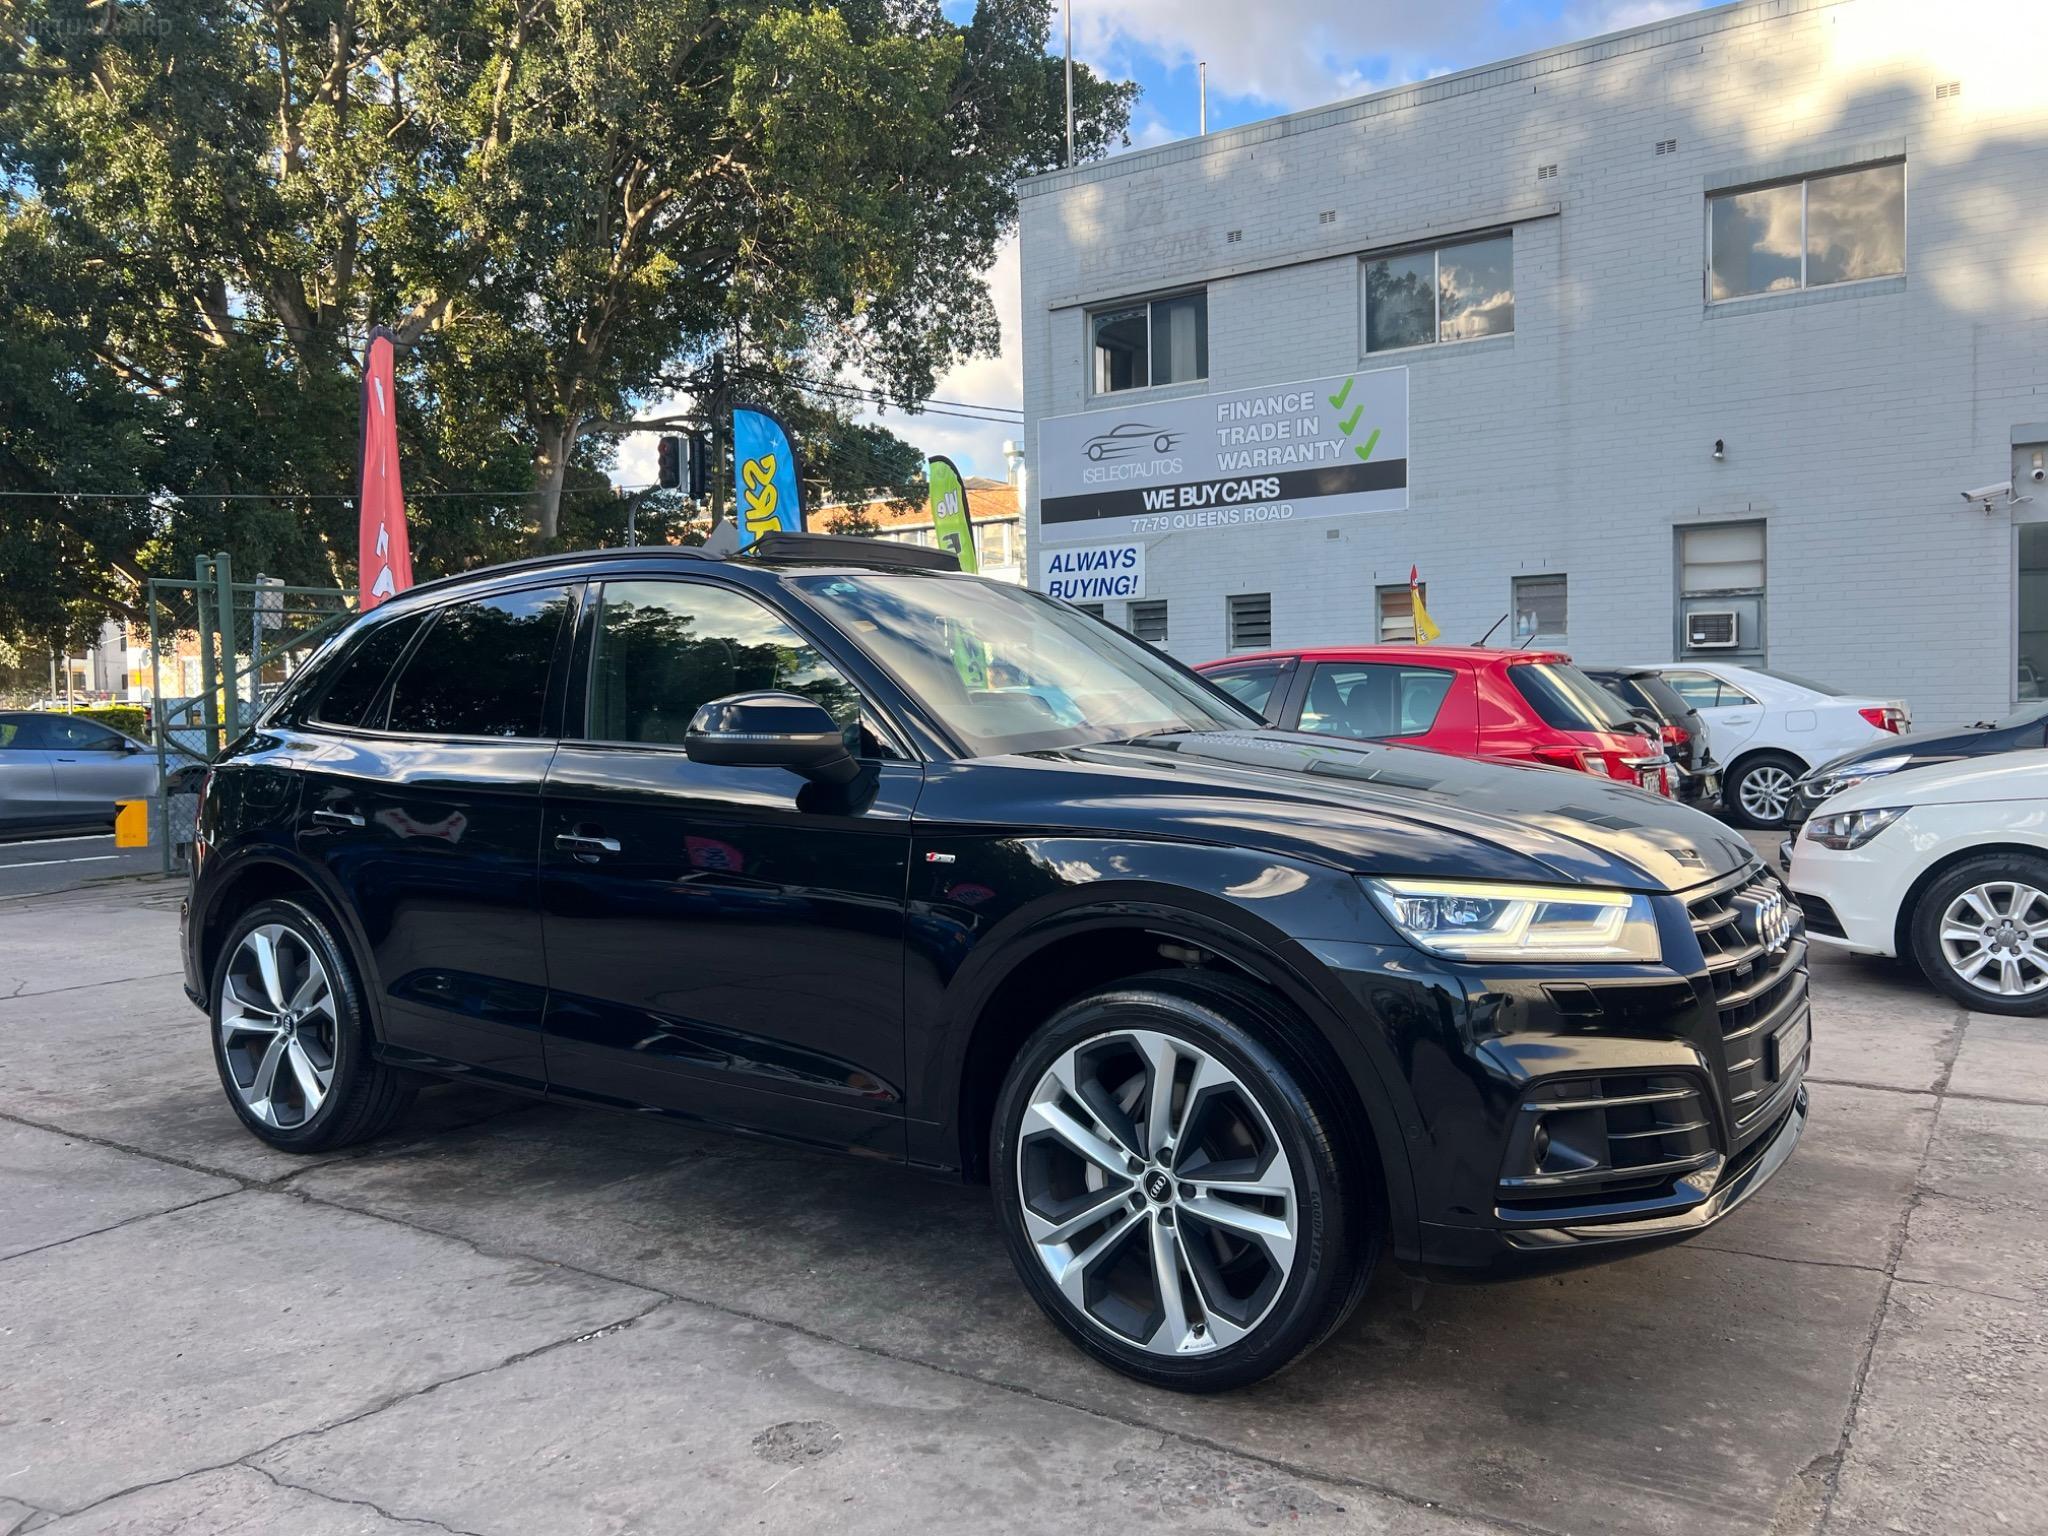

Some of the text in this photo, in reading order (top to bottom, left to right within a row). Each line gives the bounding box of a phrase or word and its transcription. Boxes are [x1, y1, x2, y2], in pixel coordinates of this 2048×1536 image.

[1217, 391, 1315, 422] FINANCE
[1216, 416, 1319, 446] TRADE IN
[1216, 438, 1346, 471] WARRANTY
[1083, 457, 1183, 484] ISELECTAUTOS
[1142, 476, 1280, 510] WE BUY CARS
[1131, 504, 1293, 532] 77-79 QUEENS ROAD
[1048, 547, 1137, 573] ALWAYS
[1049, 575, 1138, 598] BUYING!
